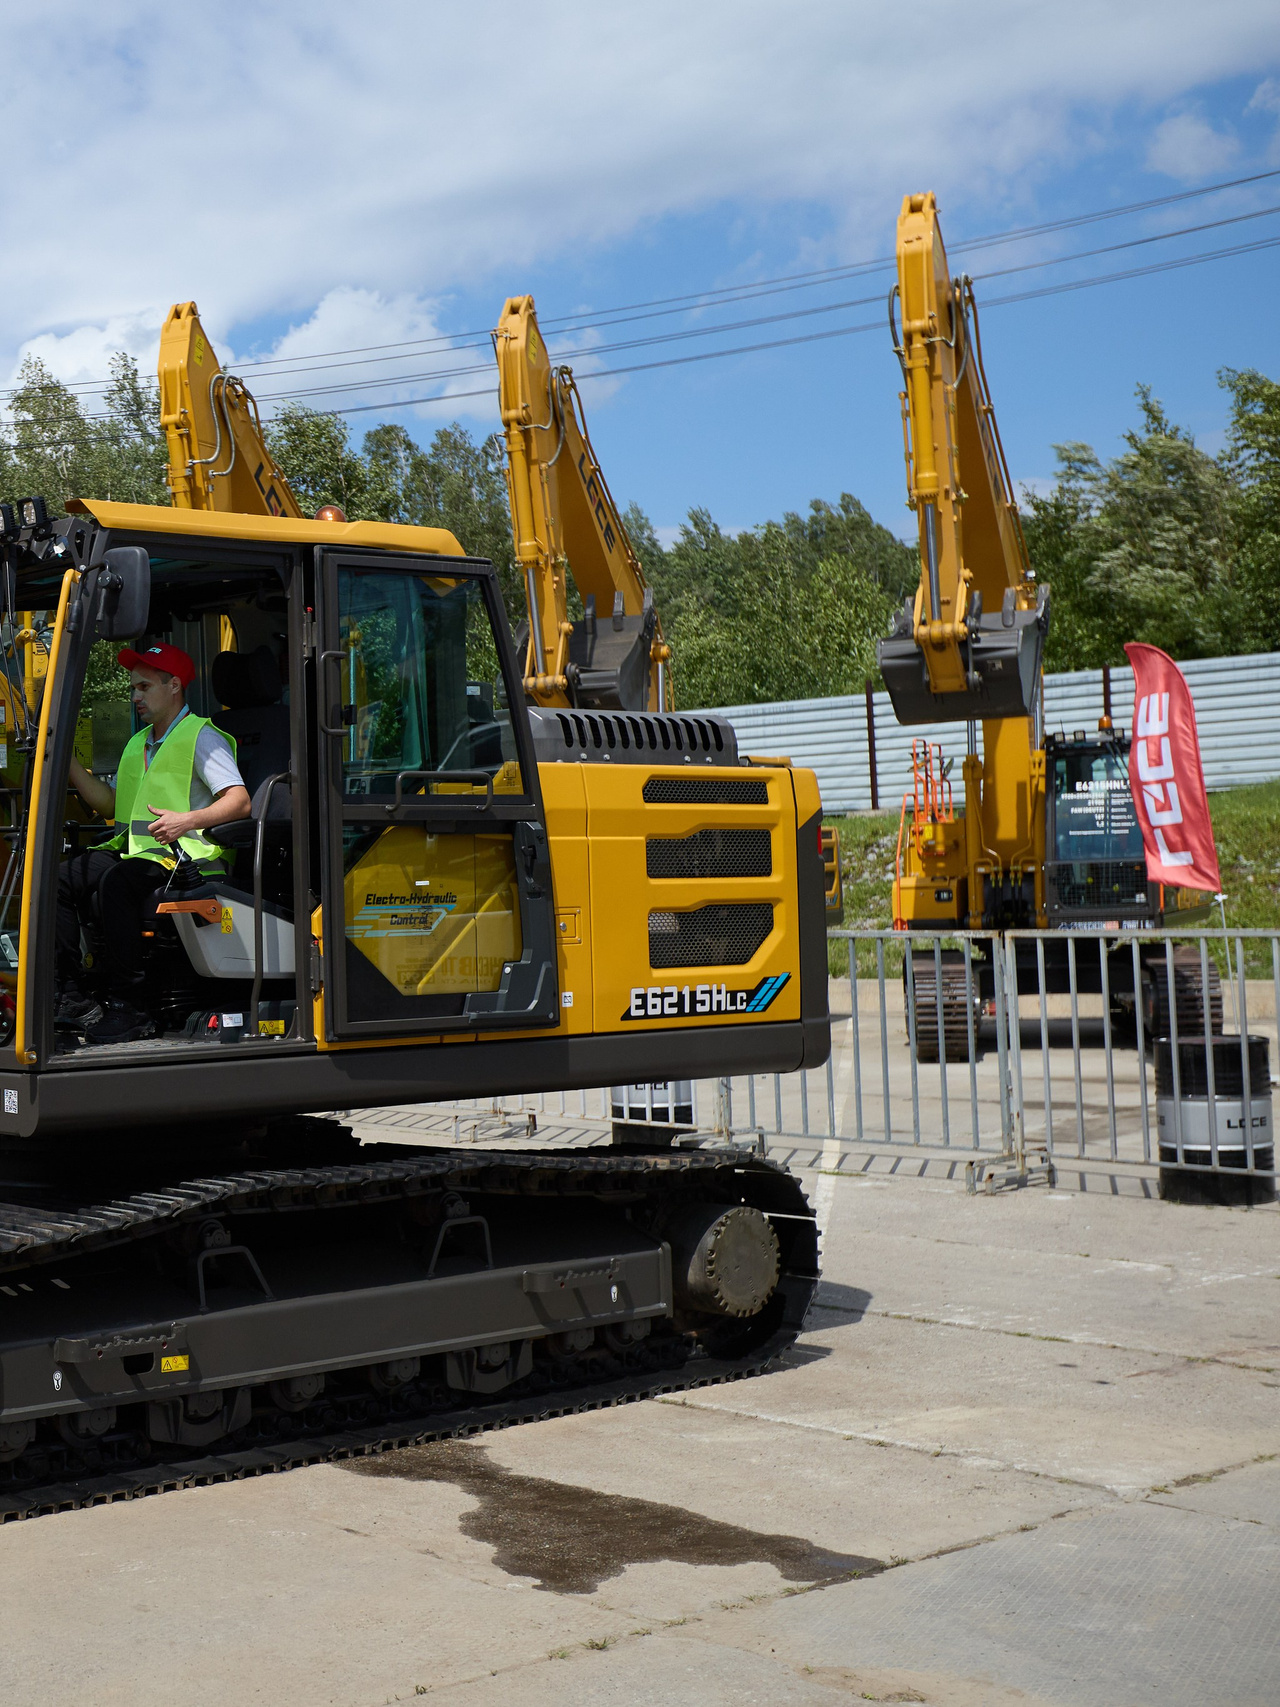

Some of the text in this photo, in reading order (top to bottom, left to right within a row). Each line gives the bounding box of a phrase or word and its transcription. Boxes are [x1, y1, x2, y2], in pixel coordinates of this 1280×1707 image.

[578, 452, 616, 554] LGCE
[365, 892, 457, 905] Electro-Hydraulic
[390, 914, 428, 925] Control
